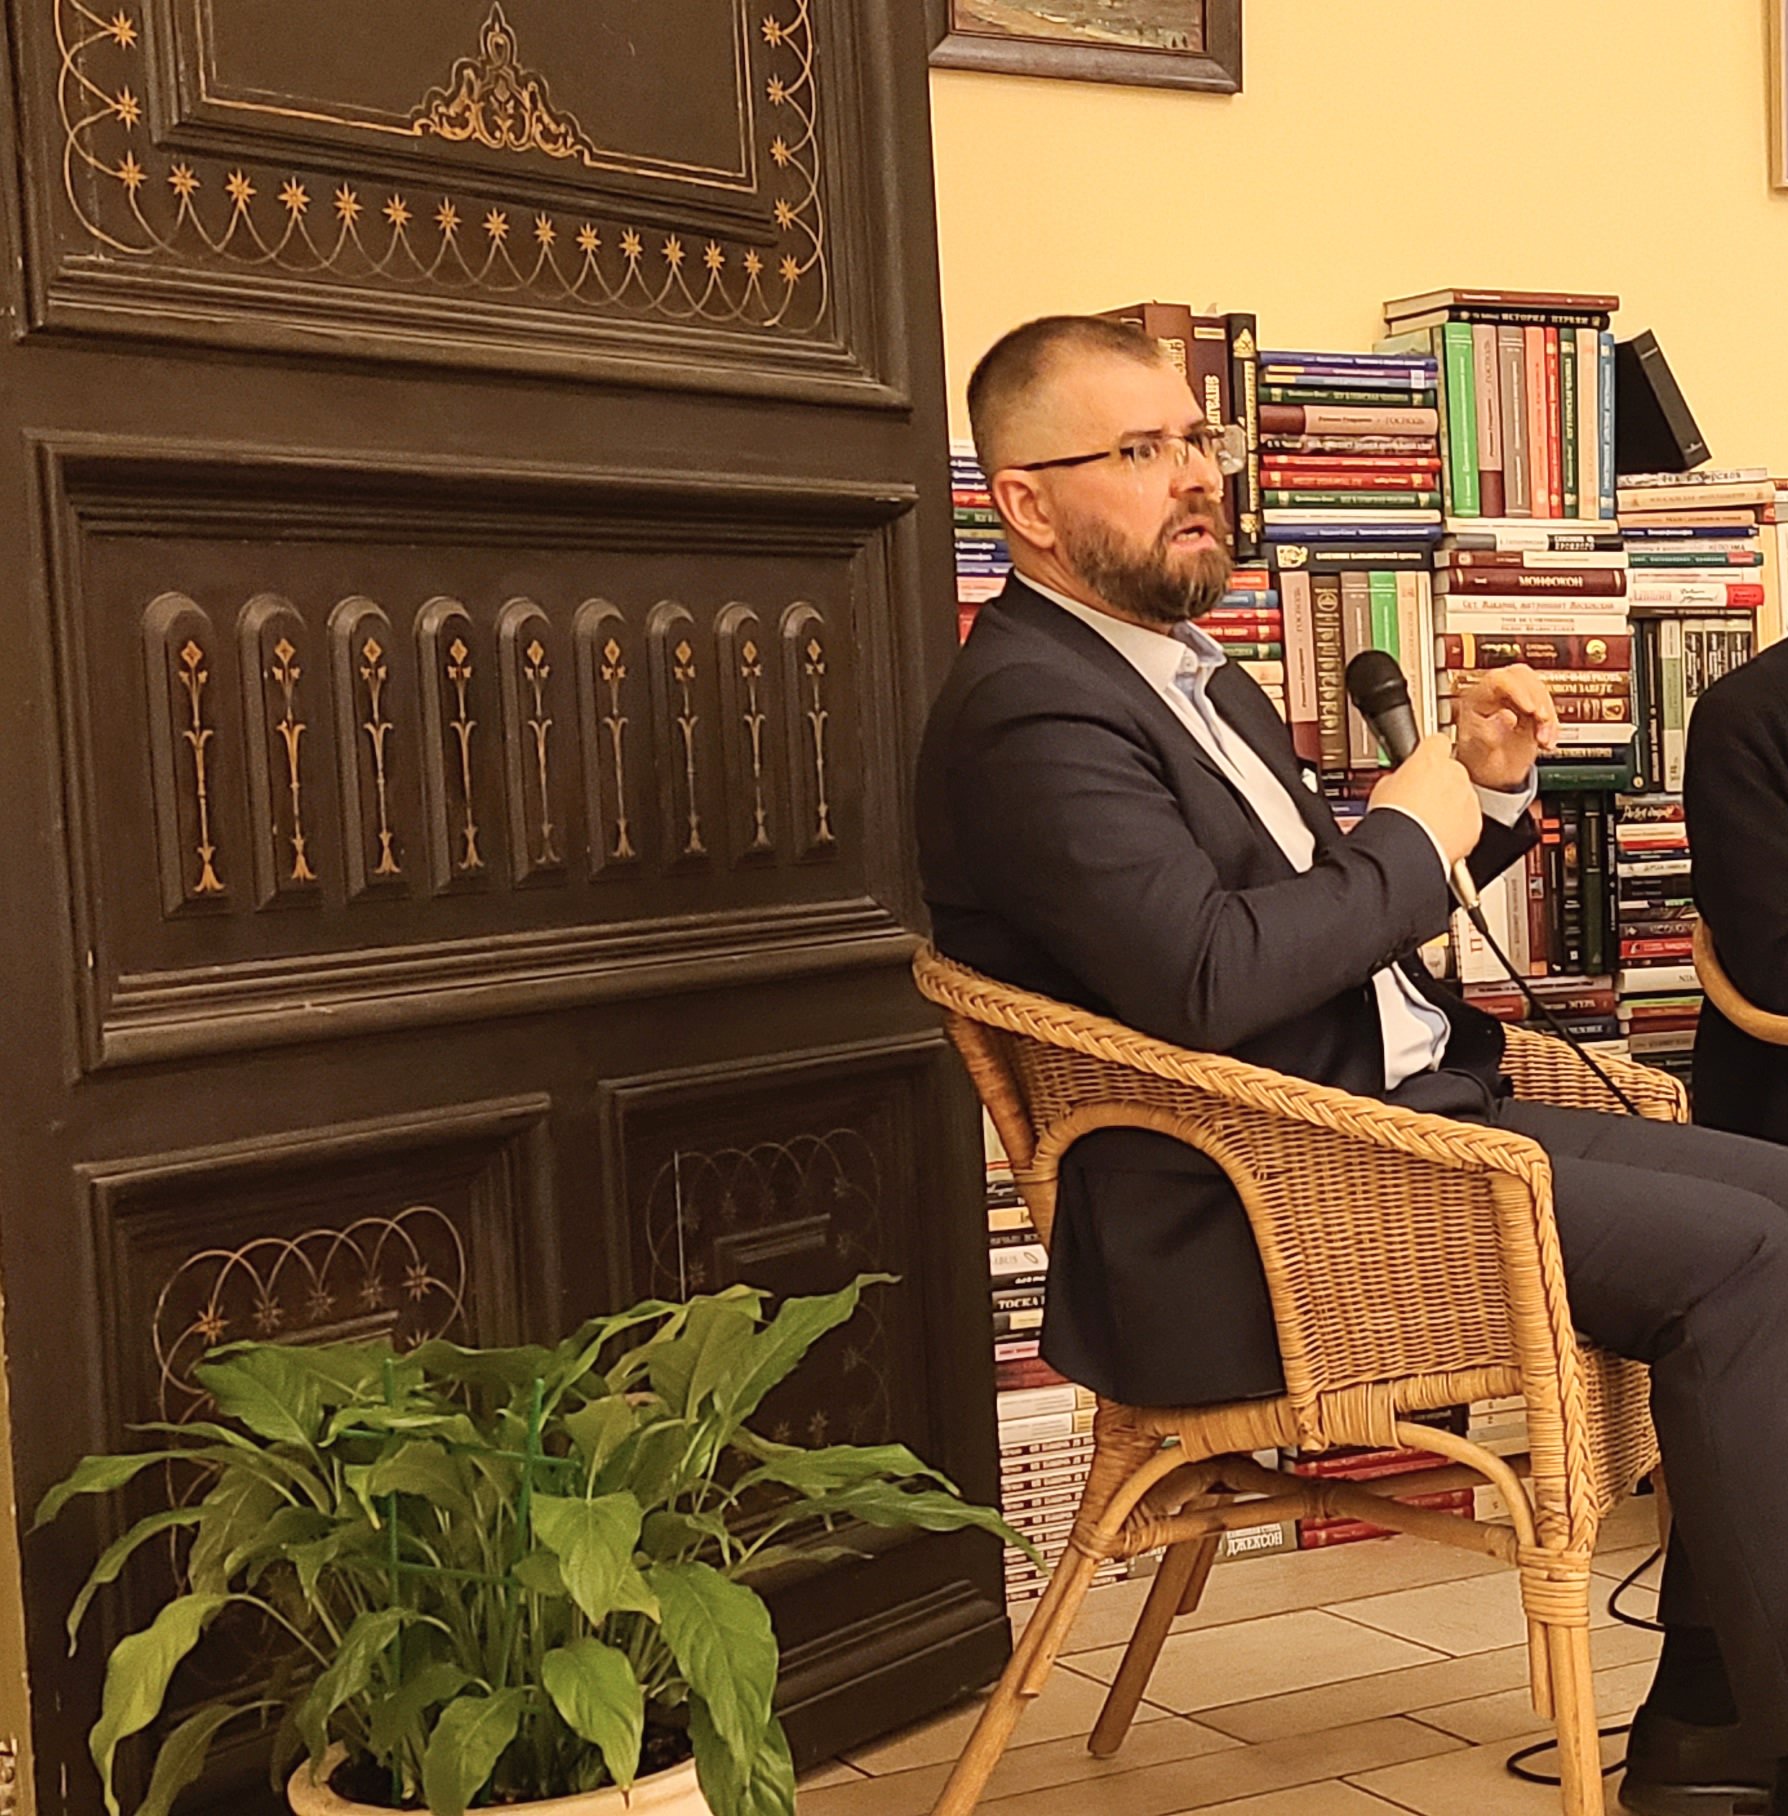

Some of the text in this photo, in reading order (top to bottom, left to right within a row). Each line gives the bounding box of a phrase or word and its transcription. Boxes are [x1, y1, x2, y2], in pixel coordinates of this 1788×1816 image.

[1518, 575, 1584, 588] МОНФОКОН
[997, 1296, 1039, 1310] ТОСКА
[1226, 1531, 1283, 1557] ДЖЕКСОН
